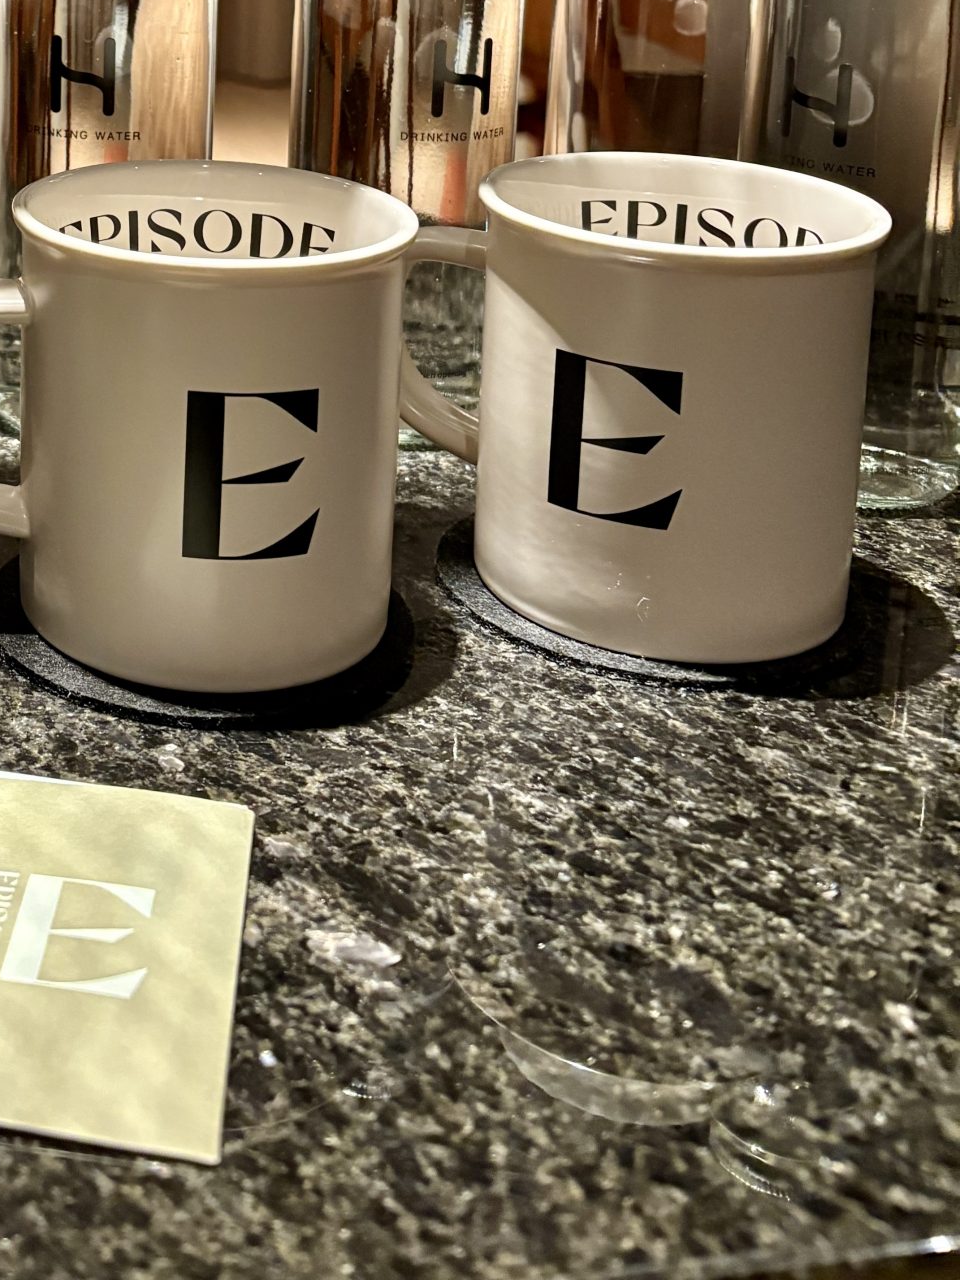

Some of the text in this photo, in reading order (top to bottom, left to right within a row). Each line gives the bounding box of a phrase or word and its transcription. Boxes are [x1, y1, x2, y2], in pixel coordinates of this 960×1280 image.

[25, 124, 141, 141] DRINKING WATER
[400, 126, 504, 142] DRINKING WATER
[823, 162, 877, 178] WATER
[547, 348, 684, 531] E
[181, 387, 321, 561] E
